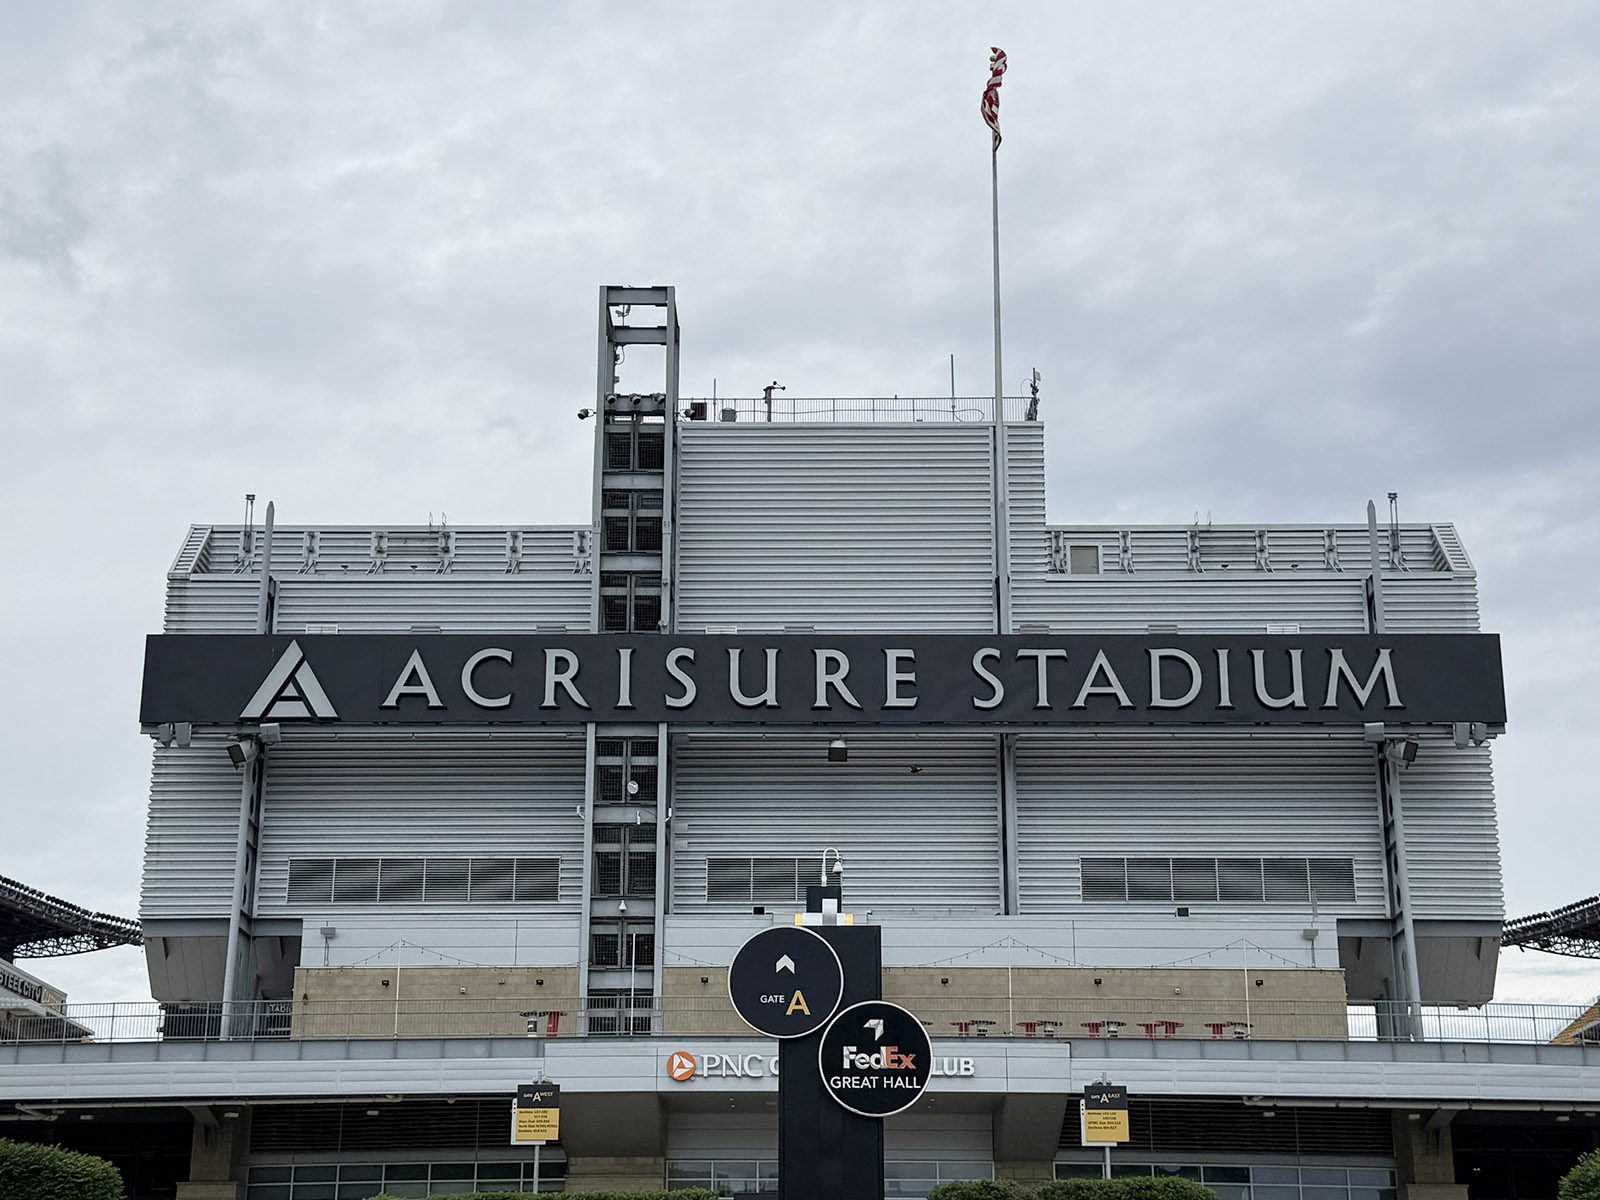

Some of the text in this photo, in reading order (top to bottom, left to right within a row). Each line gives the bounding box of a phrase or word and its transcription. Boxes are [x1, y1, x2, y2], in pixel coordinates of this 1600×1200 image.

[380, 647, 918, 709] ACRISURE
[971, 647, 1405, 709] STADIUM
[23, 980, 43, 1002] CITY
[760, 990, 811, 1016] GATE A
[702, 1053, 763, 1077] PNC
[933, 1057, 975, 1076] LUB
[843, 1045, 916, 1069] FedEx
[830, 1076, 921, 1089] GREAT HALL
[532, 1092, 542, 1102] A
[1100, 1093, 1110, 1104] A
